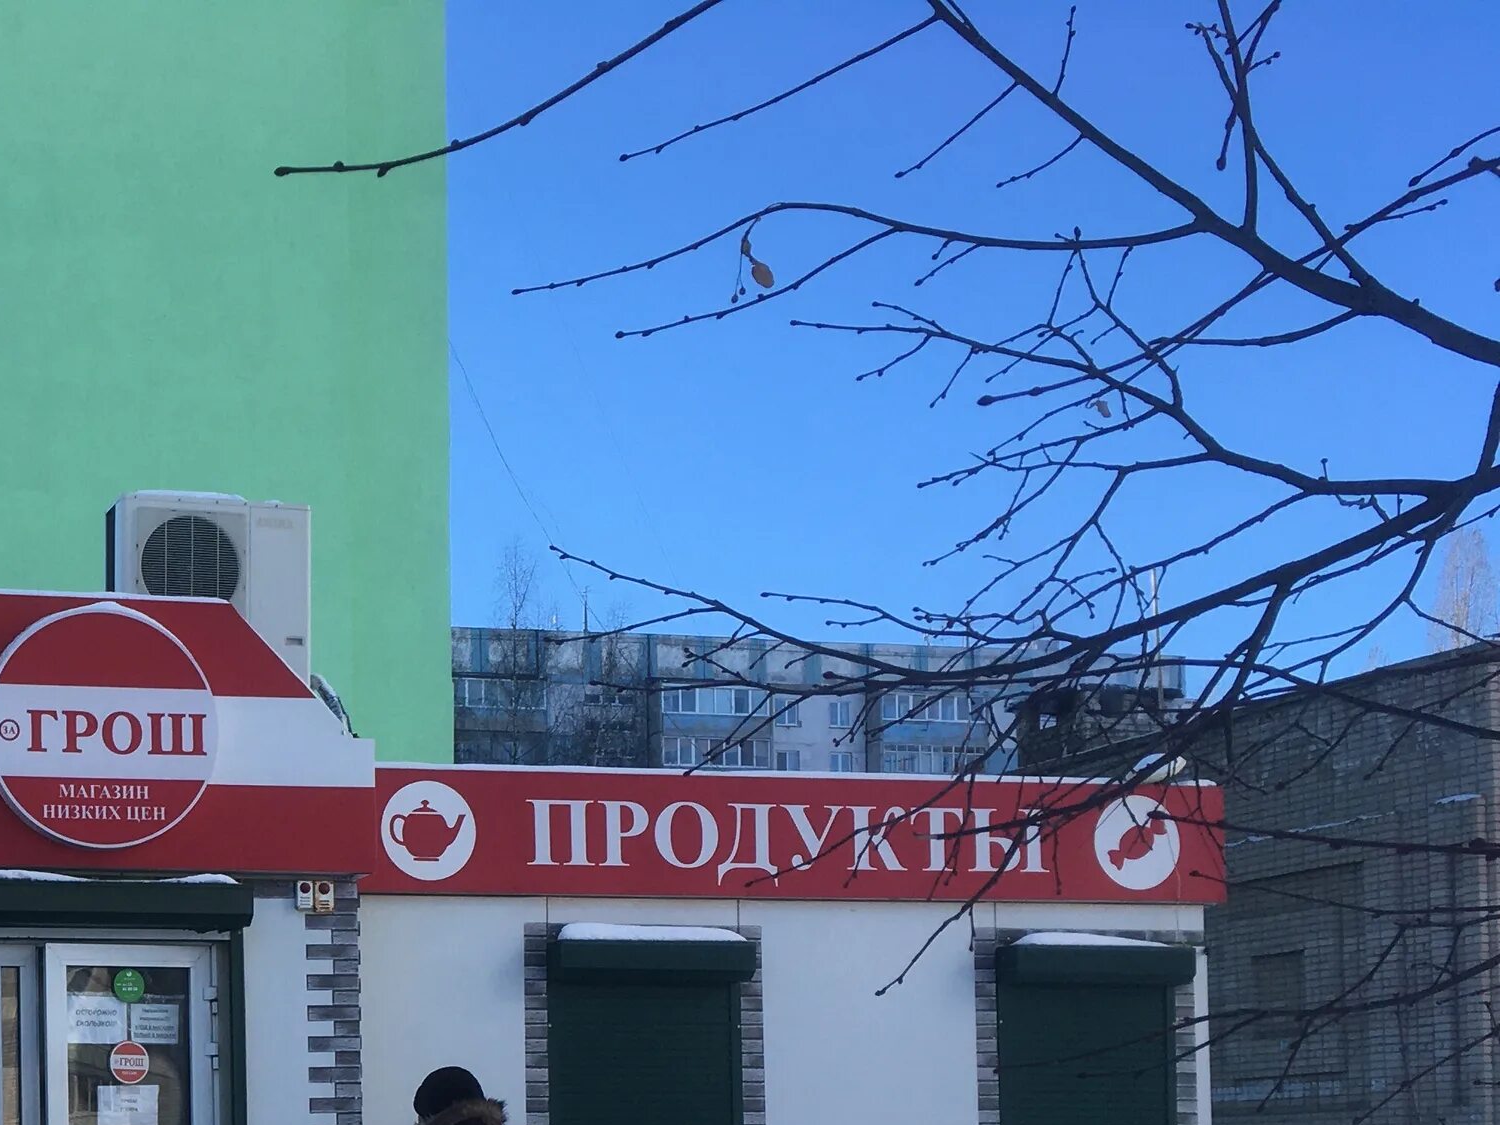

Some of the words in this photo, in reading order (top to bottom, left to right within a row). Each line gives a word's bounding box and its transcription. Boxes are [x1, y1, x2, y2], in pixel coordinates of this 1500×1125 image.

[2, 724, 17, 736] ЗА
[26, 709, 208, 756] ГРОШ
[58, 783, 150, 801] МАГАЗИН
[42, 804, 122, 822] НИЗКИХ
[126, 805, 167, 824] ЦЕН
[525, 797, 1052, 888] ПРОДУКТЫ
[119, 1057, 144, 1067] ГРОШ
